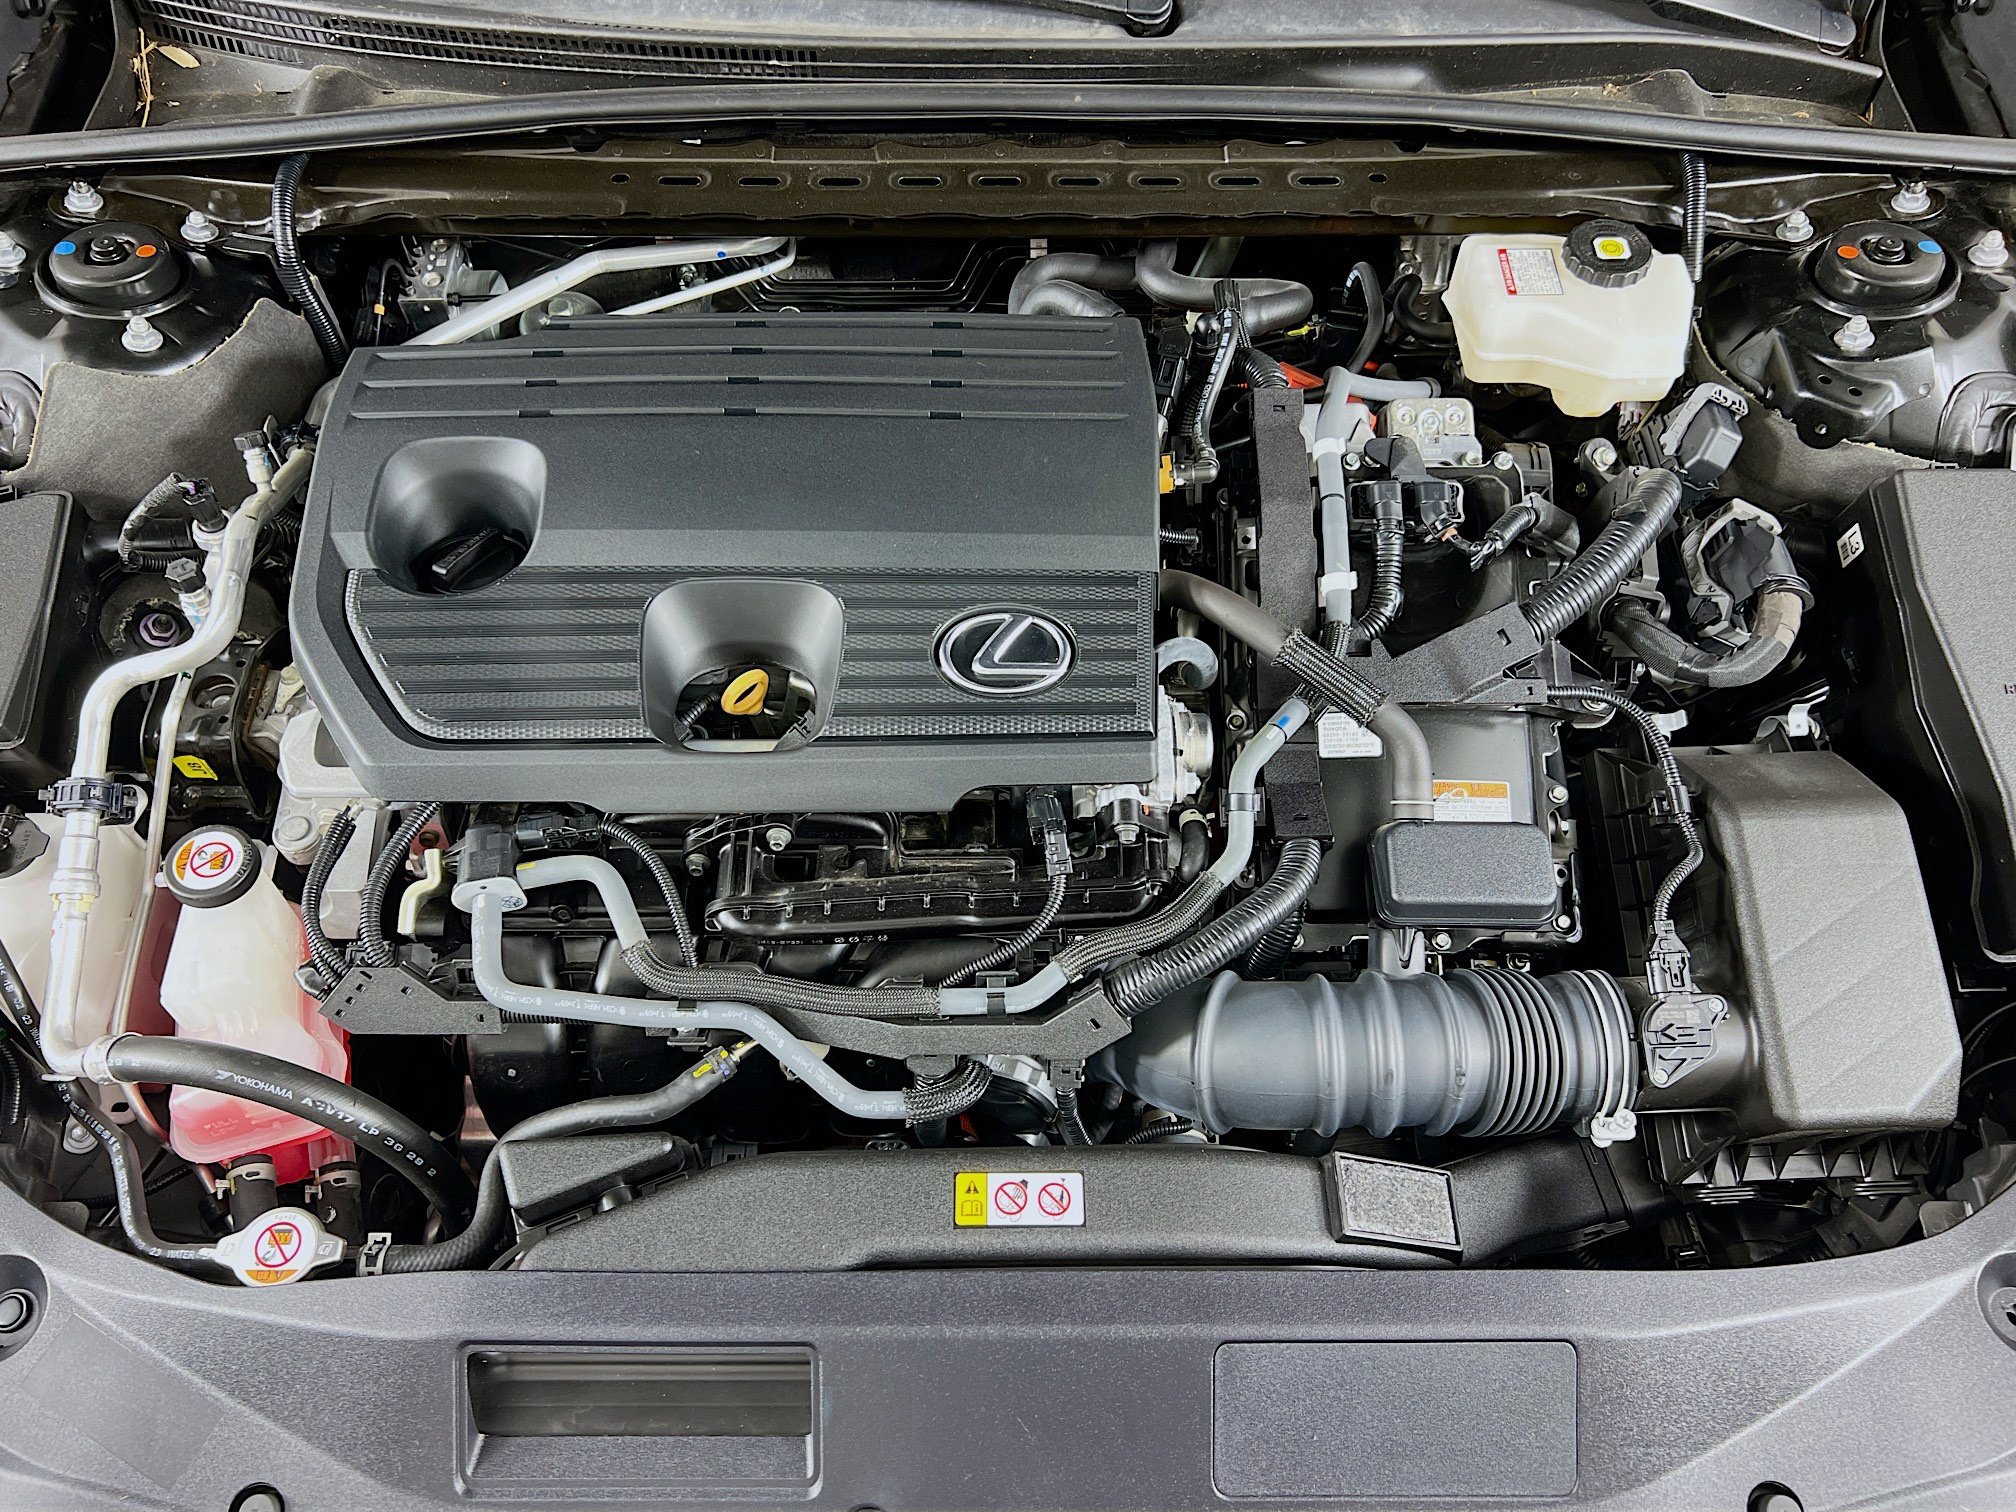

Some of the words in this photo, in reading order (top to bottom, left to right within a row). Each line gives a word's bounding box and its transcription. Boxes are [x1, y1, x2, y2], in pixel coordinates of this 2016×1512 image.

[231, 1073, 293, 1100] YOKOHAMA
[358, 1121, 380, 1137] LP
[405, 1151, 424, 1166] 29
[426, 1168, 437, 1178] 2
[166, 1249, 195, 1260] WATER
